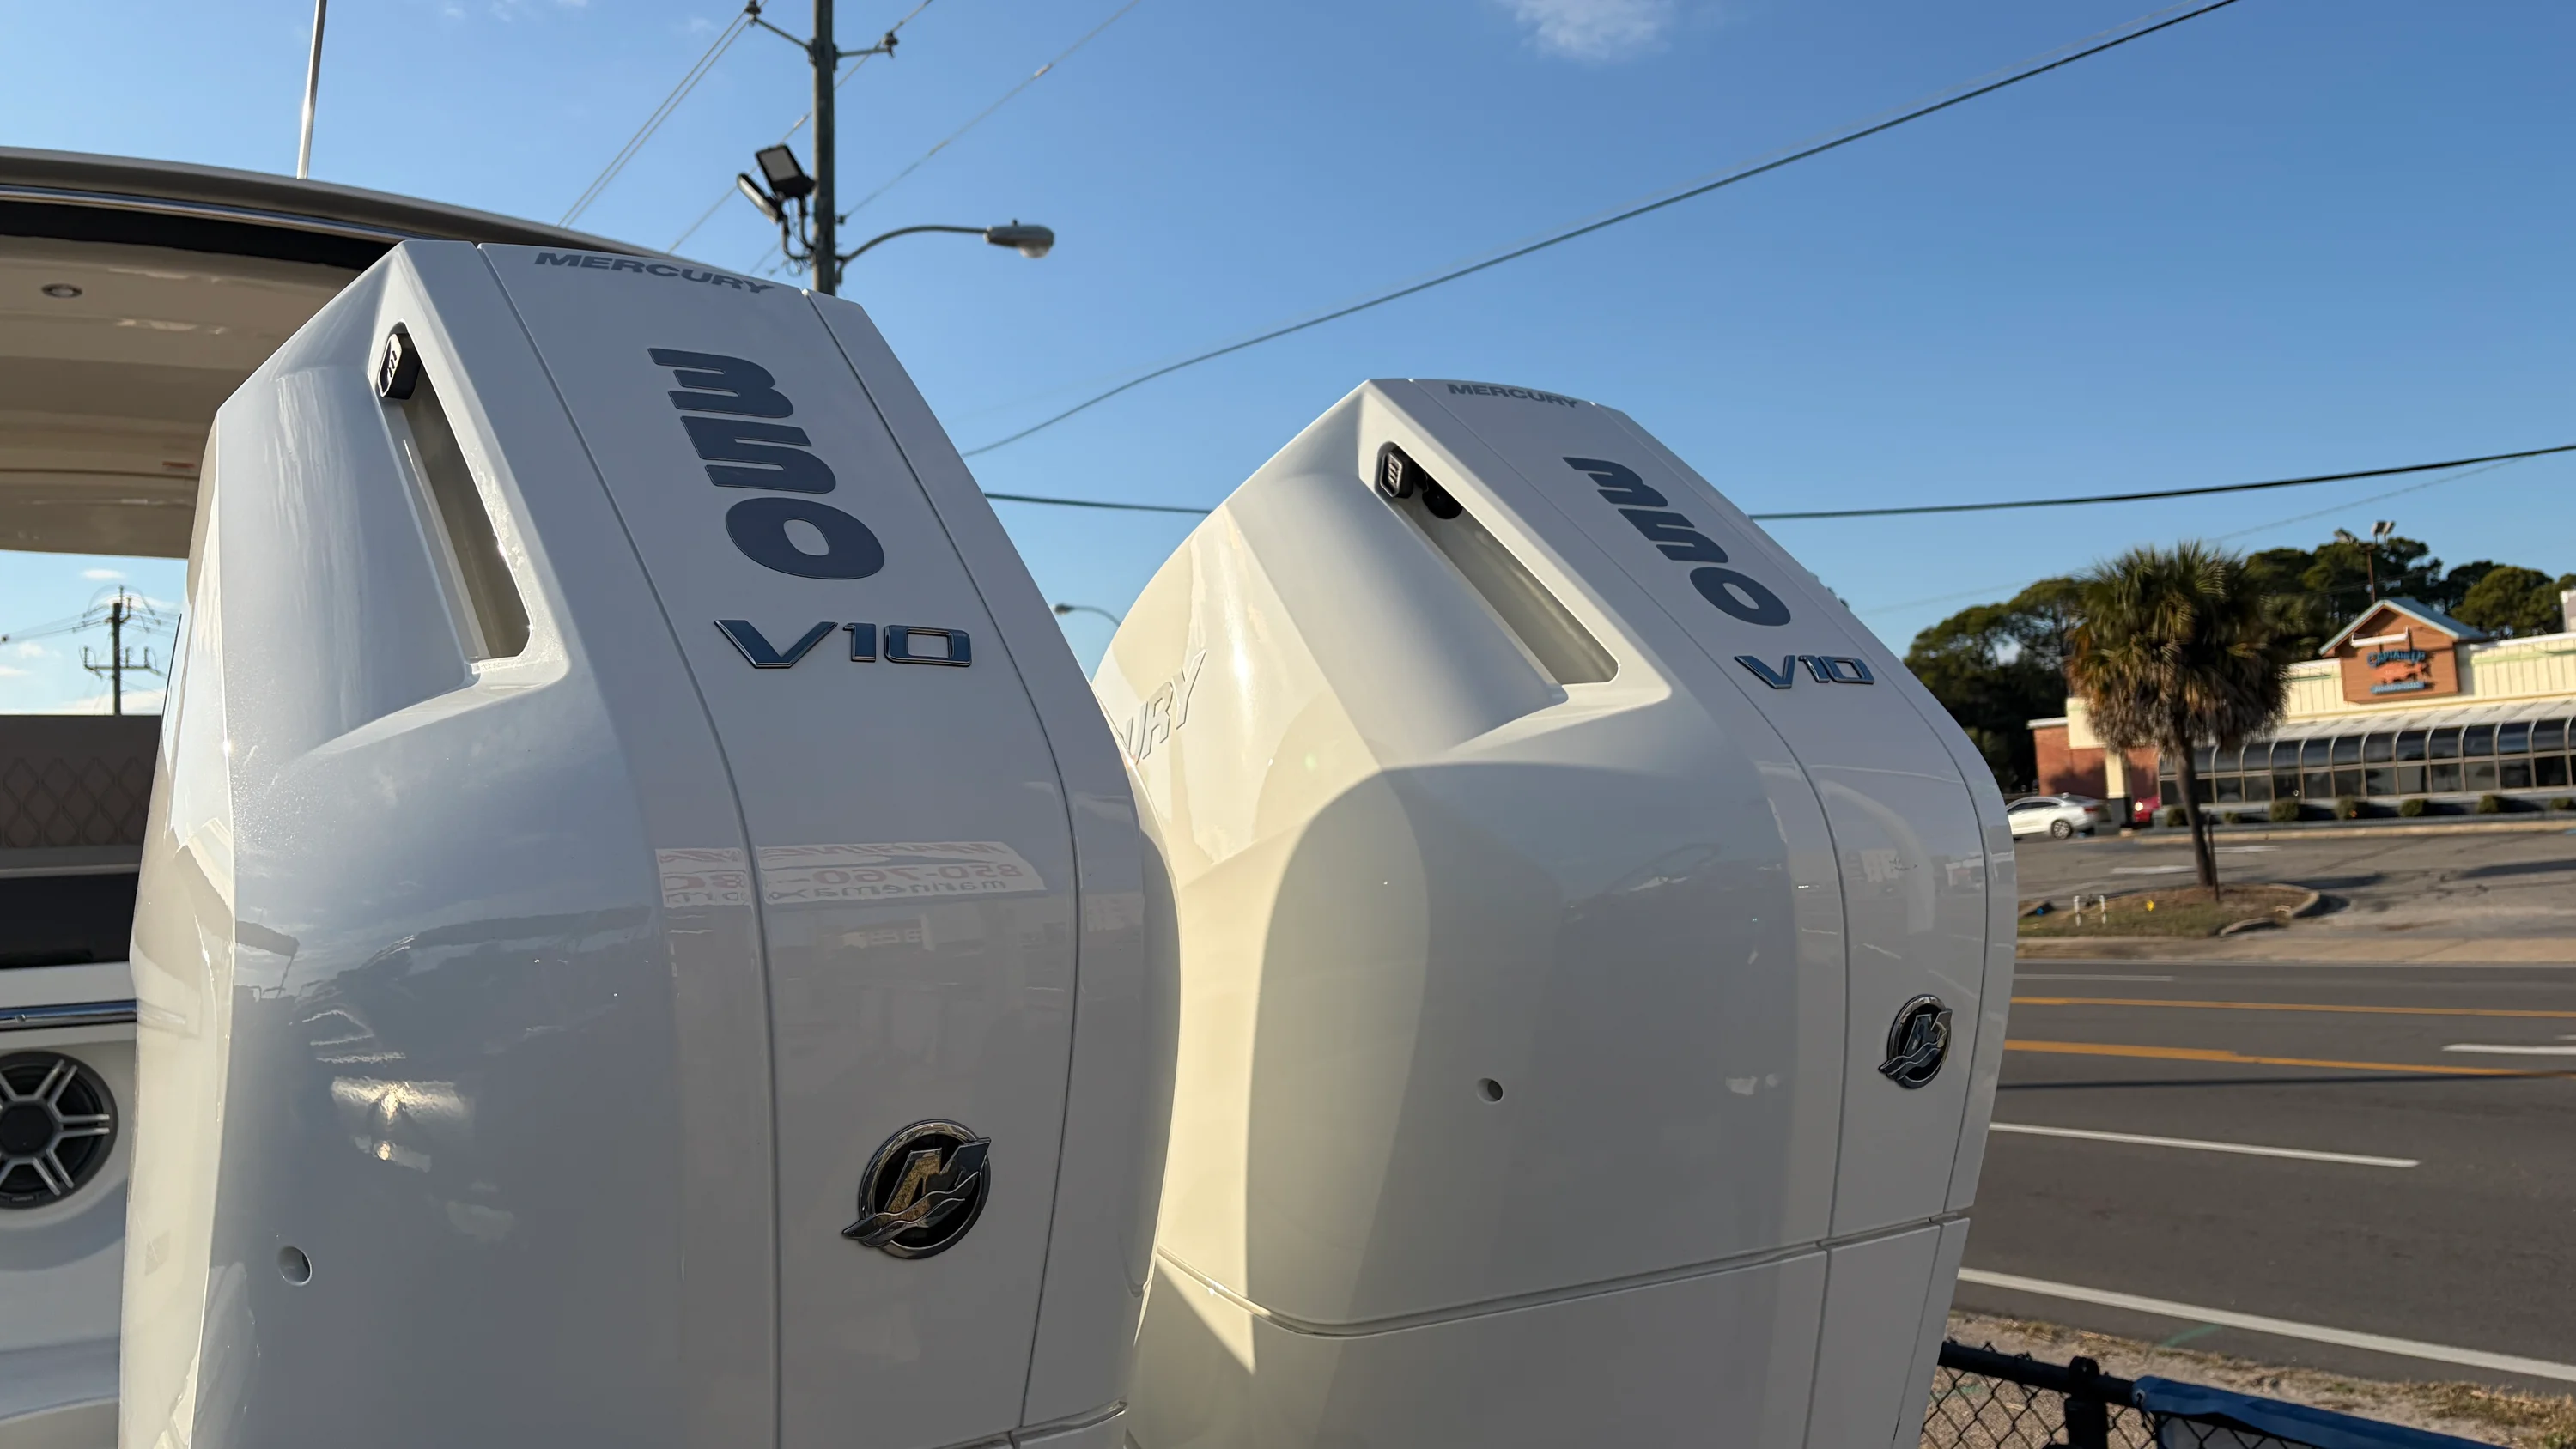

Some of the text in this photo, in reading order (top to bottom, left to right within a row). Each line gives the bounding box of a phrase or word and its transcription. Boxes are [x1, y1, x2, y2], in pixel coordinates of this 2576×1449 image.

[534, 252, 775, 294] MERCURY
[1446, 383, 1577, 408] MERCURY
[647, 347, 885, 580] 350
[1561, 456, 1791, 627] 350
[714, 620, 972, 669] V10
[1733, 655, 1875, 689] V10
